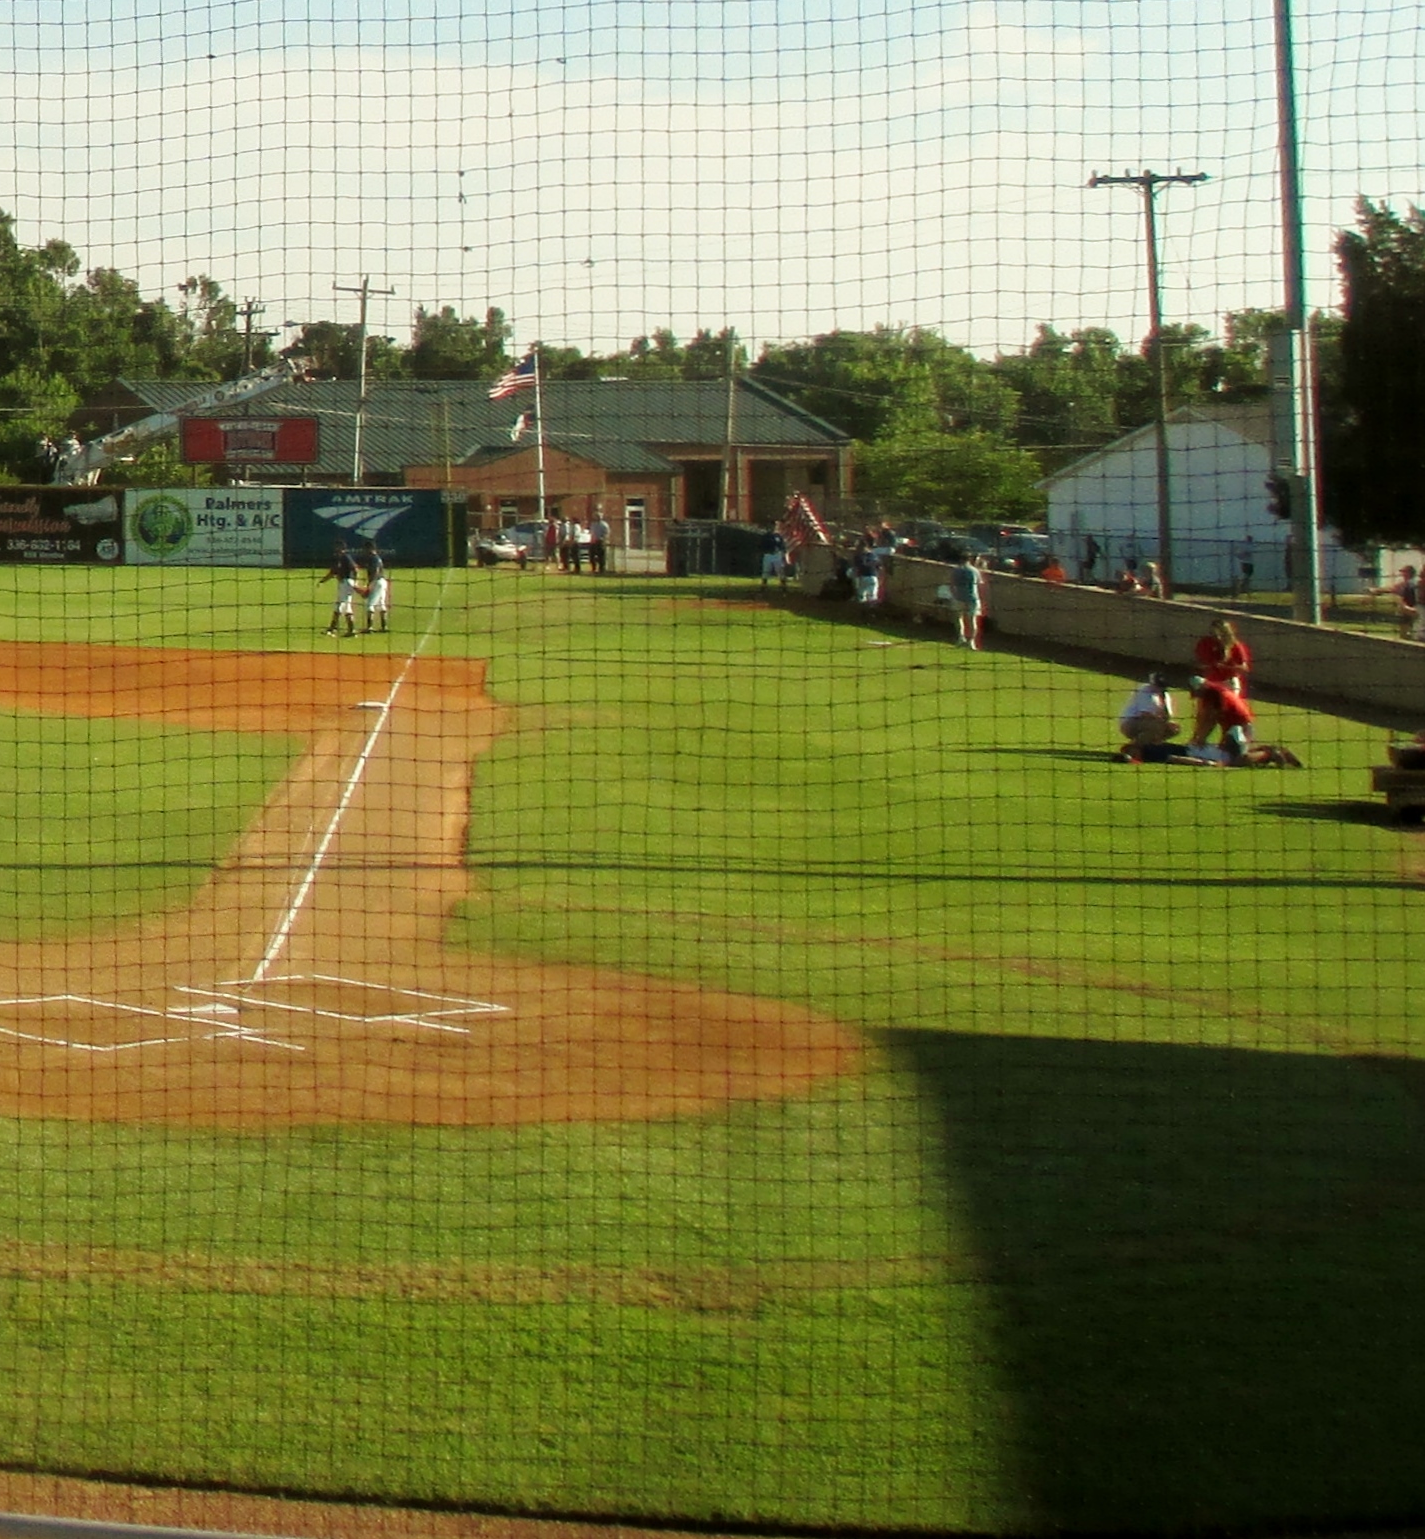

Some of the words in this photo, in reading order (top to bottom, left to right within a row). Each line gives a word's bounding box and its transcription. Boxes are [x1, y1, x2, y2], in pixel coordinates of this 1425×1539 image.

[206, 496, 272, 510] Palmers
[332, 495, 414, 503] AMTRAK
[196, 514, 231, 529] Htg.
[236, 514, 247, 527] &
[252, 514, 281, 527] A/C
